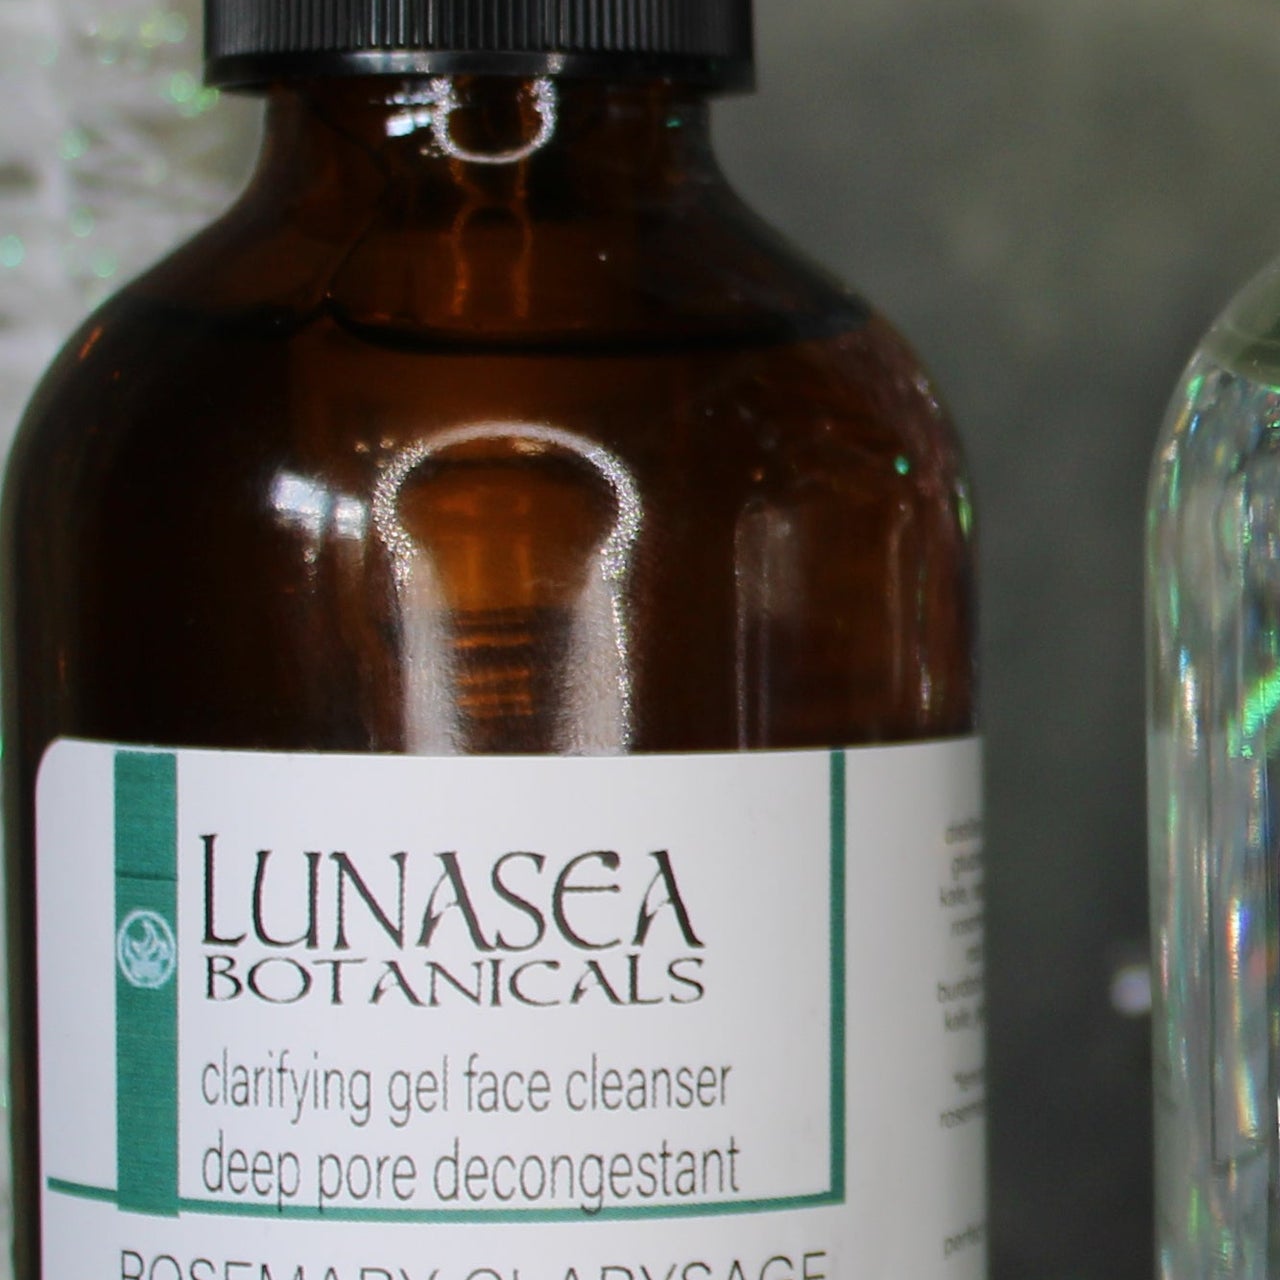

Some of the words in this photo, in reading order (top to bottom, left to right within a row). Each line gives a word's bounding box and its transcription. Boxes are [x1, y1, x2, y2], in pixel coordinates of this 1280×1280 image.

[199, 834, 705, 951] LUNASEA
[205, 953, 705, 1007] BOTANICALS
[201, 1048, 371, 1128] clarifying
[388, 1053, 450, 1126] gel
[463, 1052, 551, 1113] face
[565, 1053, 732, 1112] cleanser
[201, 1132, 298, 1212] deep
[317, 1152, 418, 1212] pore
[432, 1137, 740, 1214] decongestant
